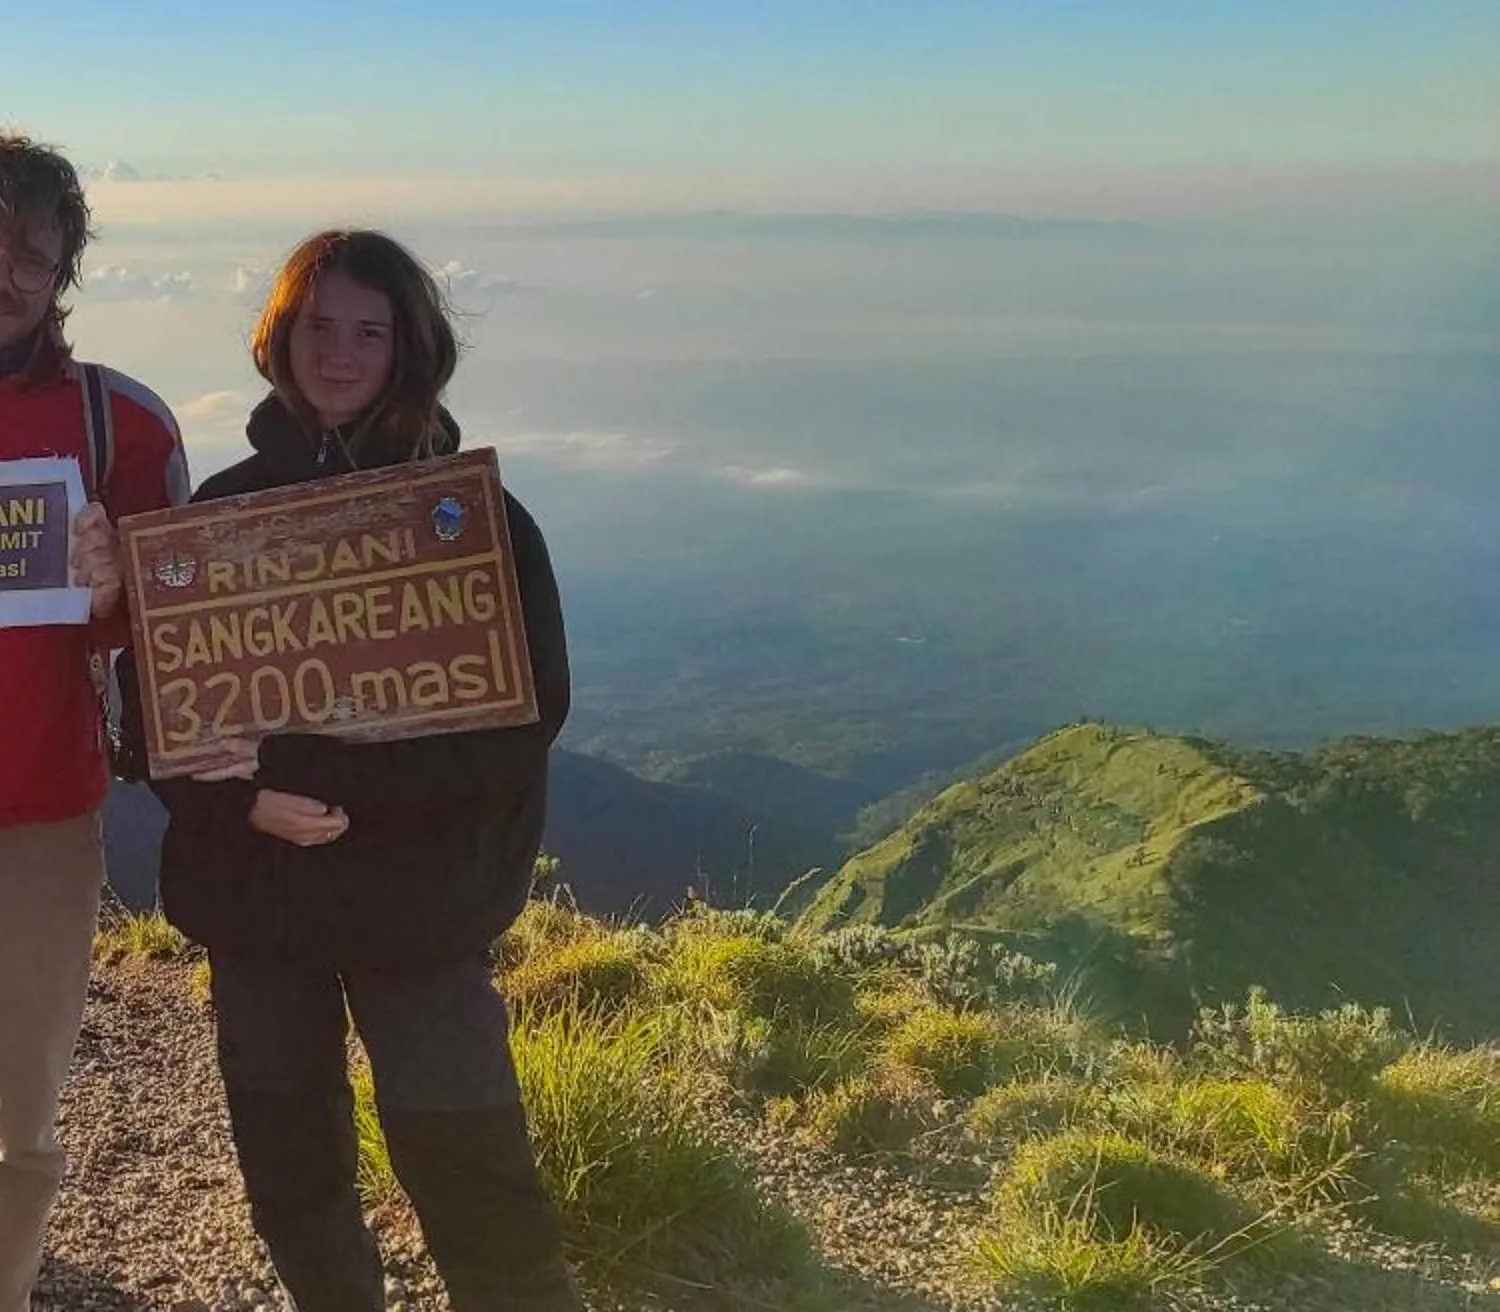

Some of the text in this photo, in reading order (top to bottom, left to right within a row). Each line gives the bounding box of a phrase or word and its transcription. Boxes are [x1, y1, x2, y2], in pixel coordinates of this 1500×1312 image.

[208, 528, 416, 594] RINJANI
[152, 570, 498, 673] SANGKAREANG
[159, 629, 507, 743] 3200 masl
